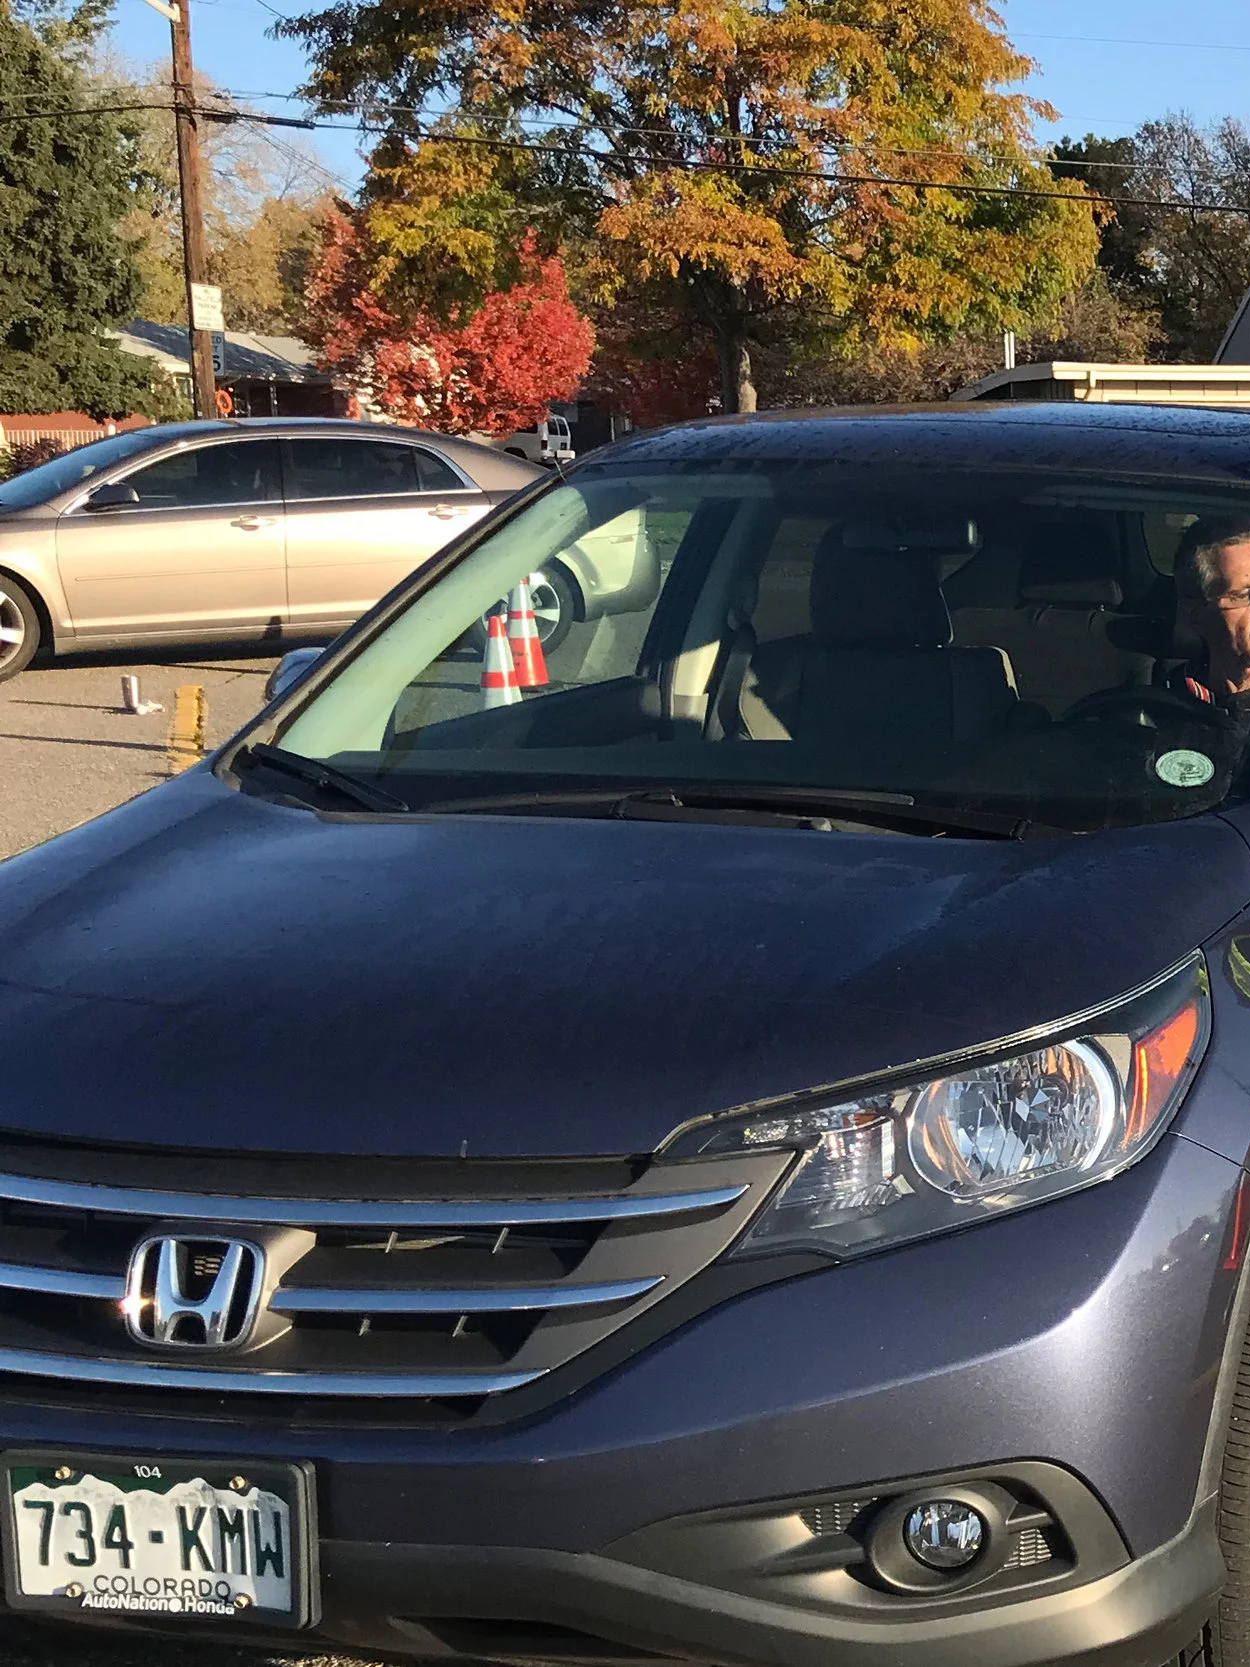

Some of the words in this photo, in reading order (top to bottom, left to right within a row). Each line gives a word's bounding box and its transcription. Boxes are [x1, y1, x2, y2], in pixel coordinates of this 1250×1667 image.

[134, 1465, 162, 1478] 104
[23, 1500, 284, 1577] 734-KMW
[93, 1575, 231, 1598] COLORADO
[81, 1593, 168, 1611] AutoNation
